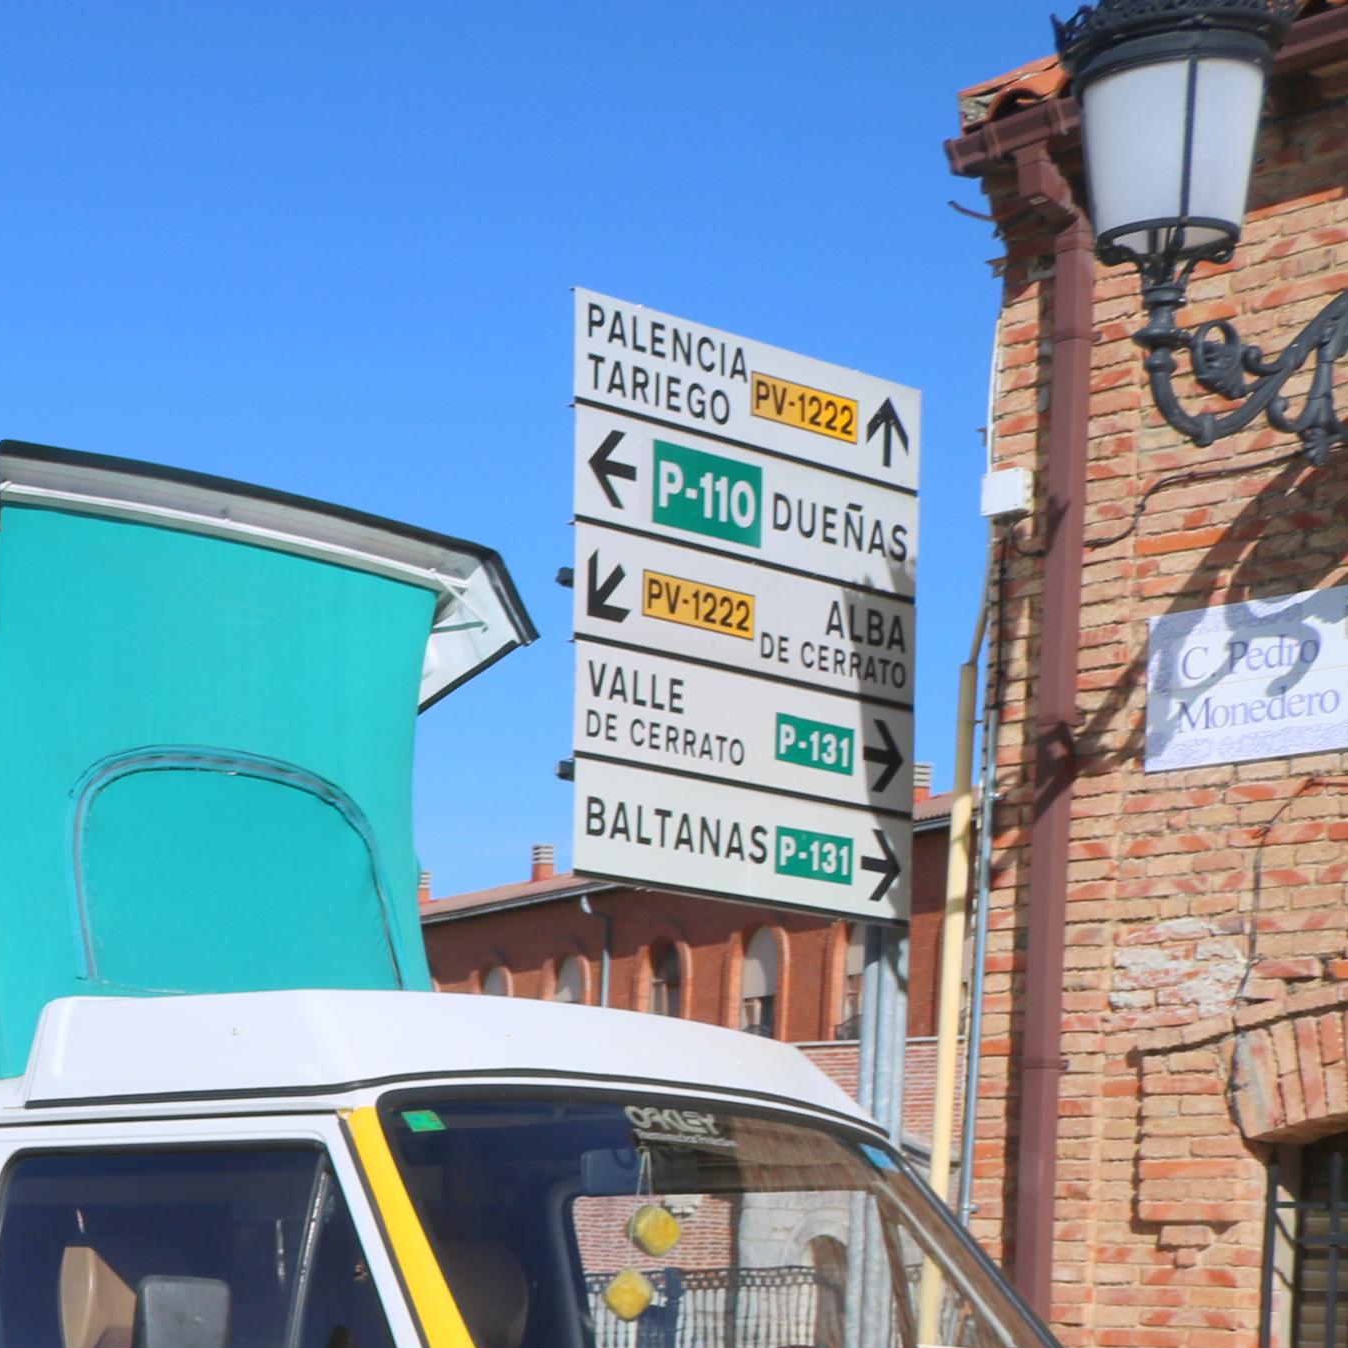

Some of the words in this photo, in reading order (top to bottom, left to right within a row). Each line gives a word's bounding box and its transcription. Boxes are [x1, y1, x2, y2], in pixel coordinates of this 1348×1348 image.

[587, 302, 748, 383] PALENCIA
[587, 353, 730, 425] TARIEGO
[755, 379, 854, 436] PV-1222
[658, 460, 756, 528] P-110
[772, 492, 908, 562] DUEÑAS
[647, 578, 750, 632] PV-1222
[825, 600, 906, 653] ALBA
[760, 632, 790, 663] DE
[801, 641, 907, 689] CERRATO
[1182, 646, 1217, 681] C.
[1229, 633, 1320, 674] Pedro
[588, 659, 685, 714] VALLE
[1177, 685, 1340, 734] Monedero
[586, 709, 618, 742] DE
[629, 718, 745, 766] CERRATO
[779, 723, 850, 768] P-131
[585, 795, 768, 865] BALTANAS
[779, 835, 850, 876] P-131
[624, 1105, 720, 1136] OAKLEY
